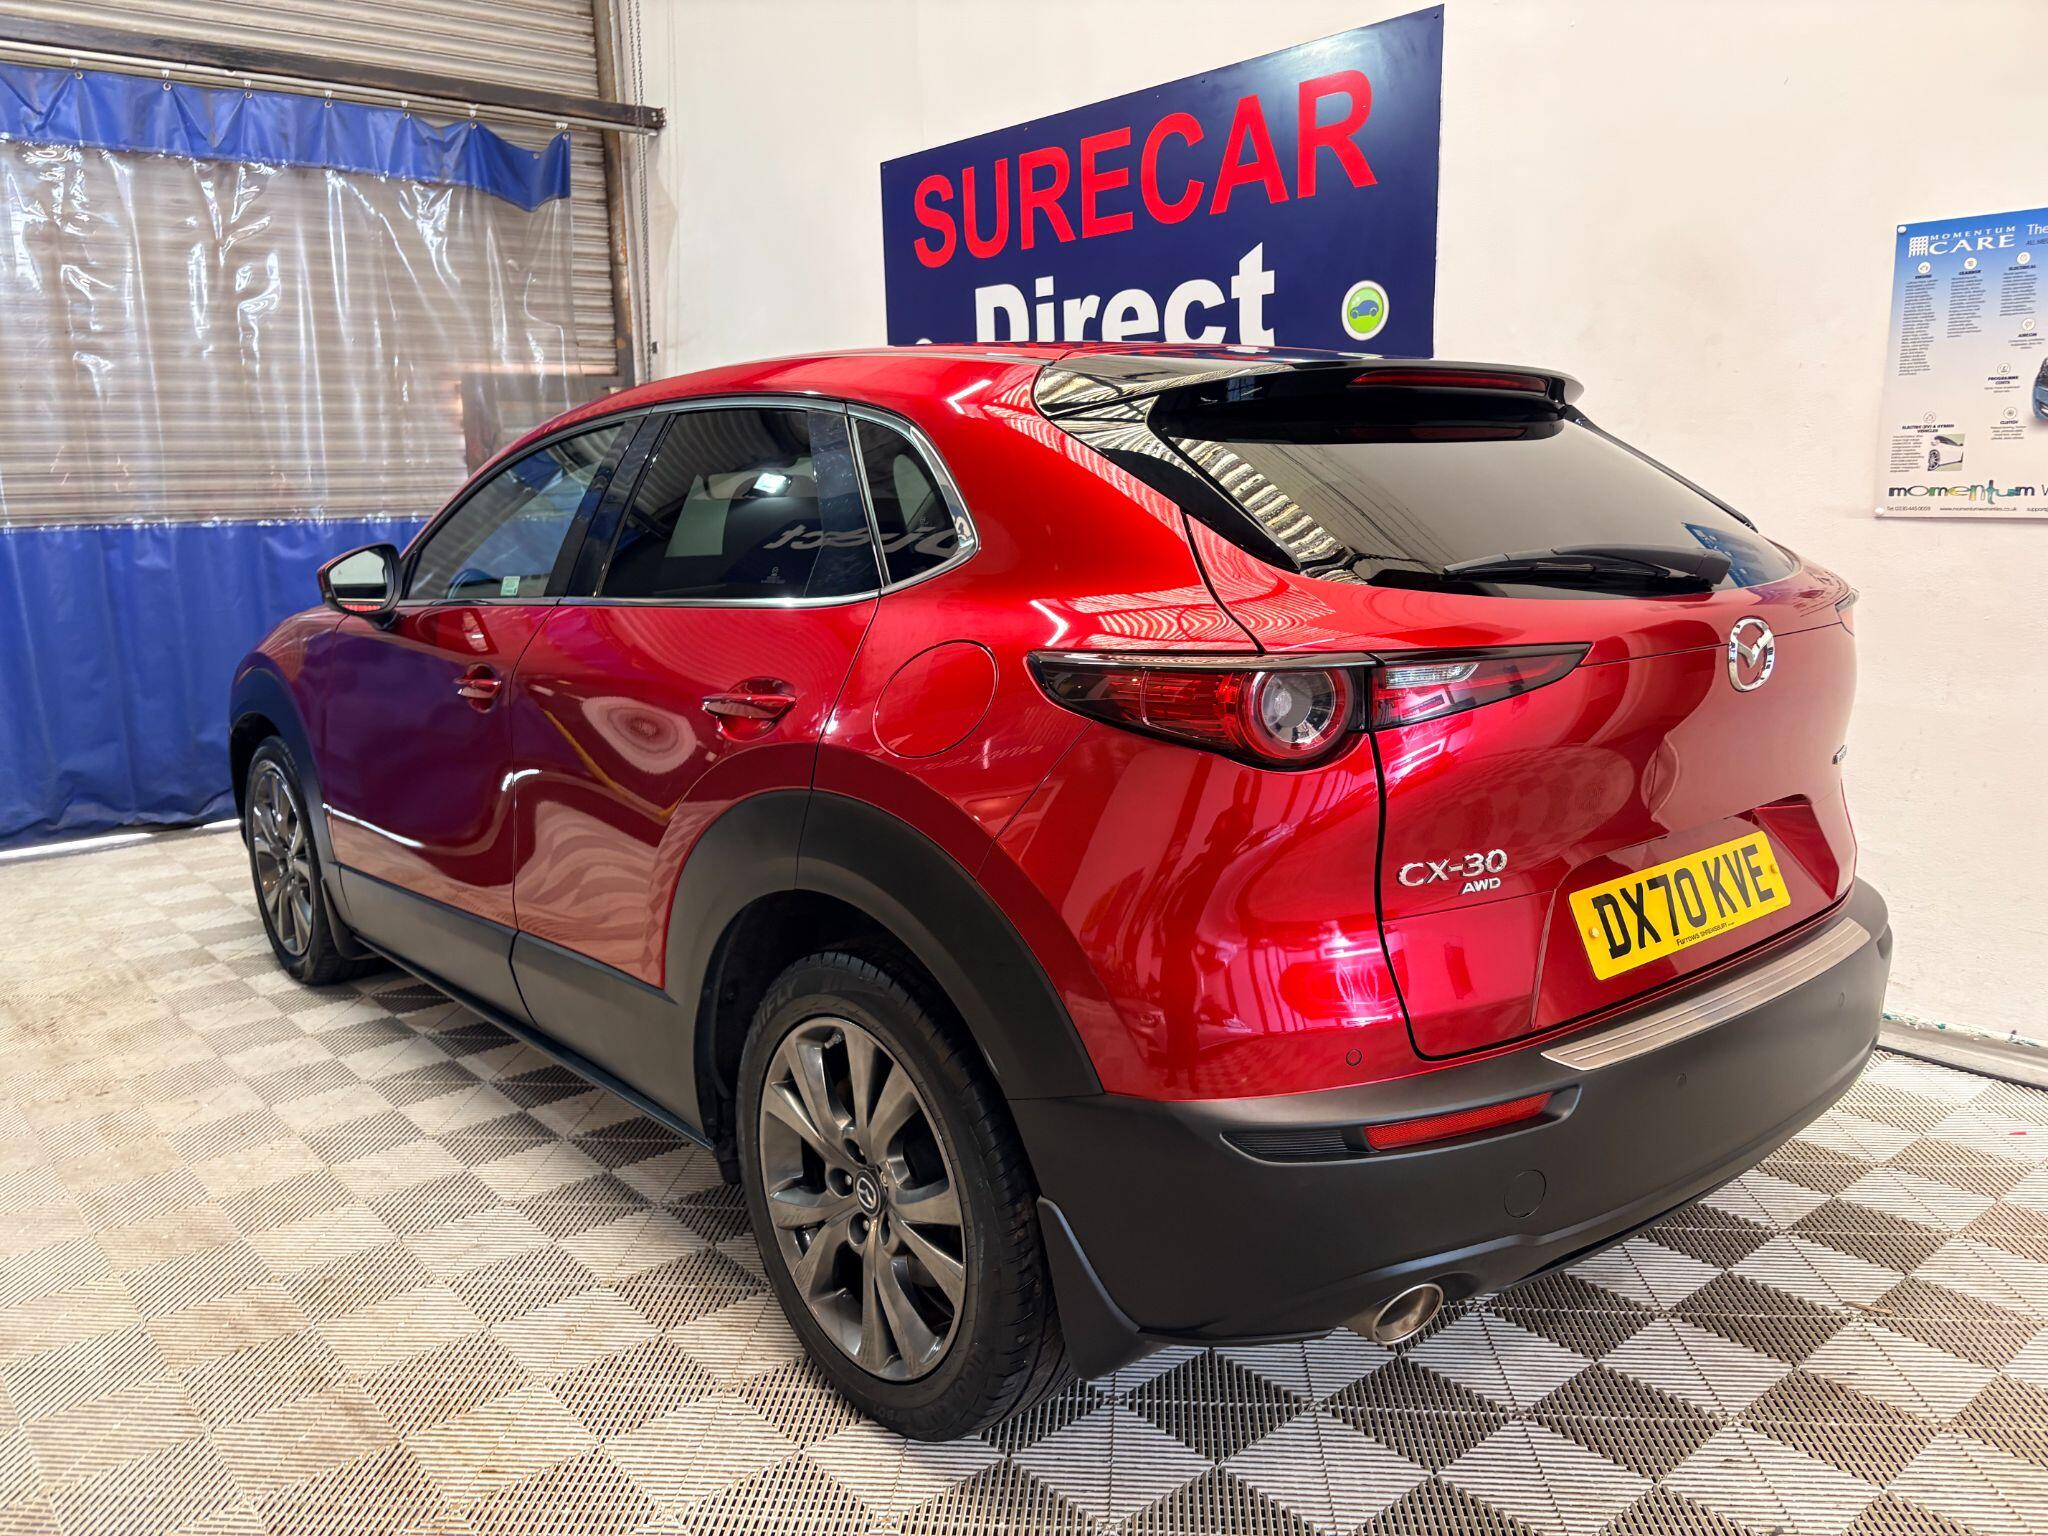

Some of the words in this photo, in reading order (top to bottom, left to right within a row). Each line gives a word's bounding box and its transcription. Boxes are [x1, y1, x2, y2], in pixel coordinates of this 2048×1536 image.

[914, 69, 1378, 268] SURECAR
[1930, 226, 2016, 241] MOMENTUM
[1930, 234, 2016, 255] CARE
[974, 242, 1275, 345] Direct
[1888, 480, 2035, 505] momentum
[1398, 849, 1508, 887] CX-30
[1461, 877, 1501, 894] AWD
[1591, 868, 1707, 960] DX70
[1702, 844, 1776, 920] KVE
